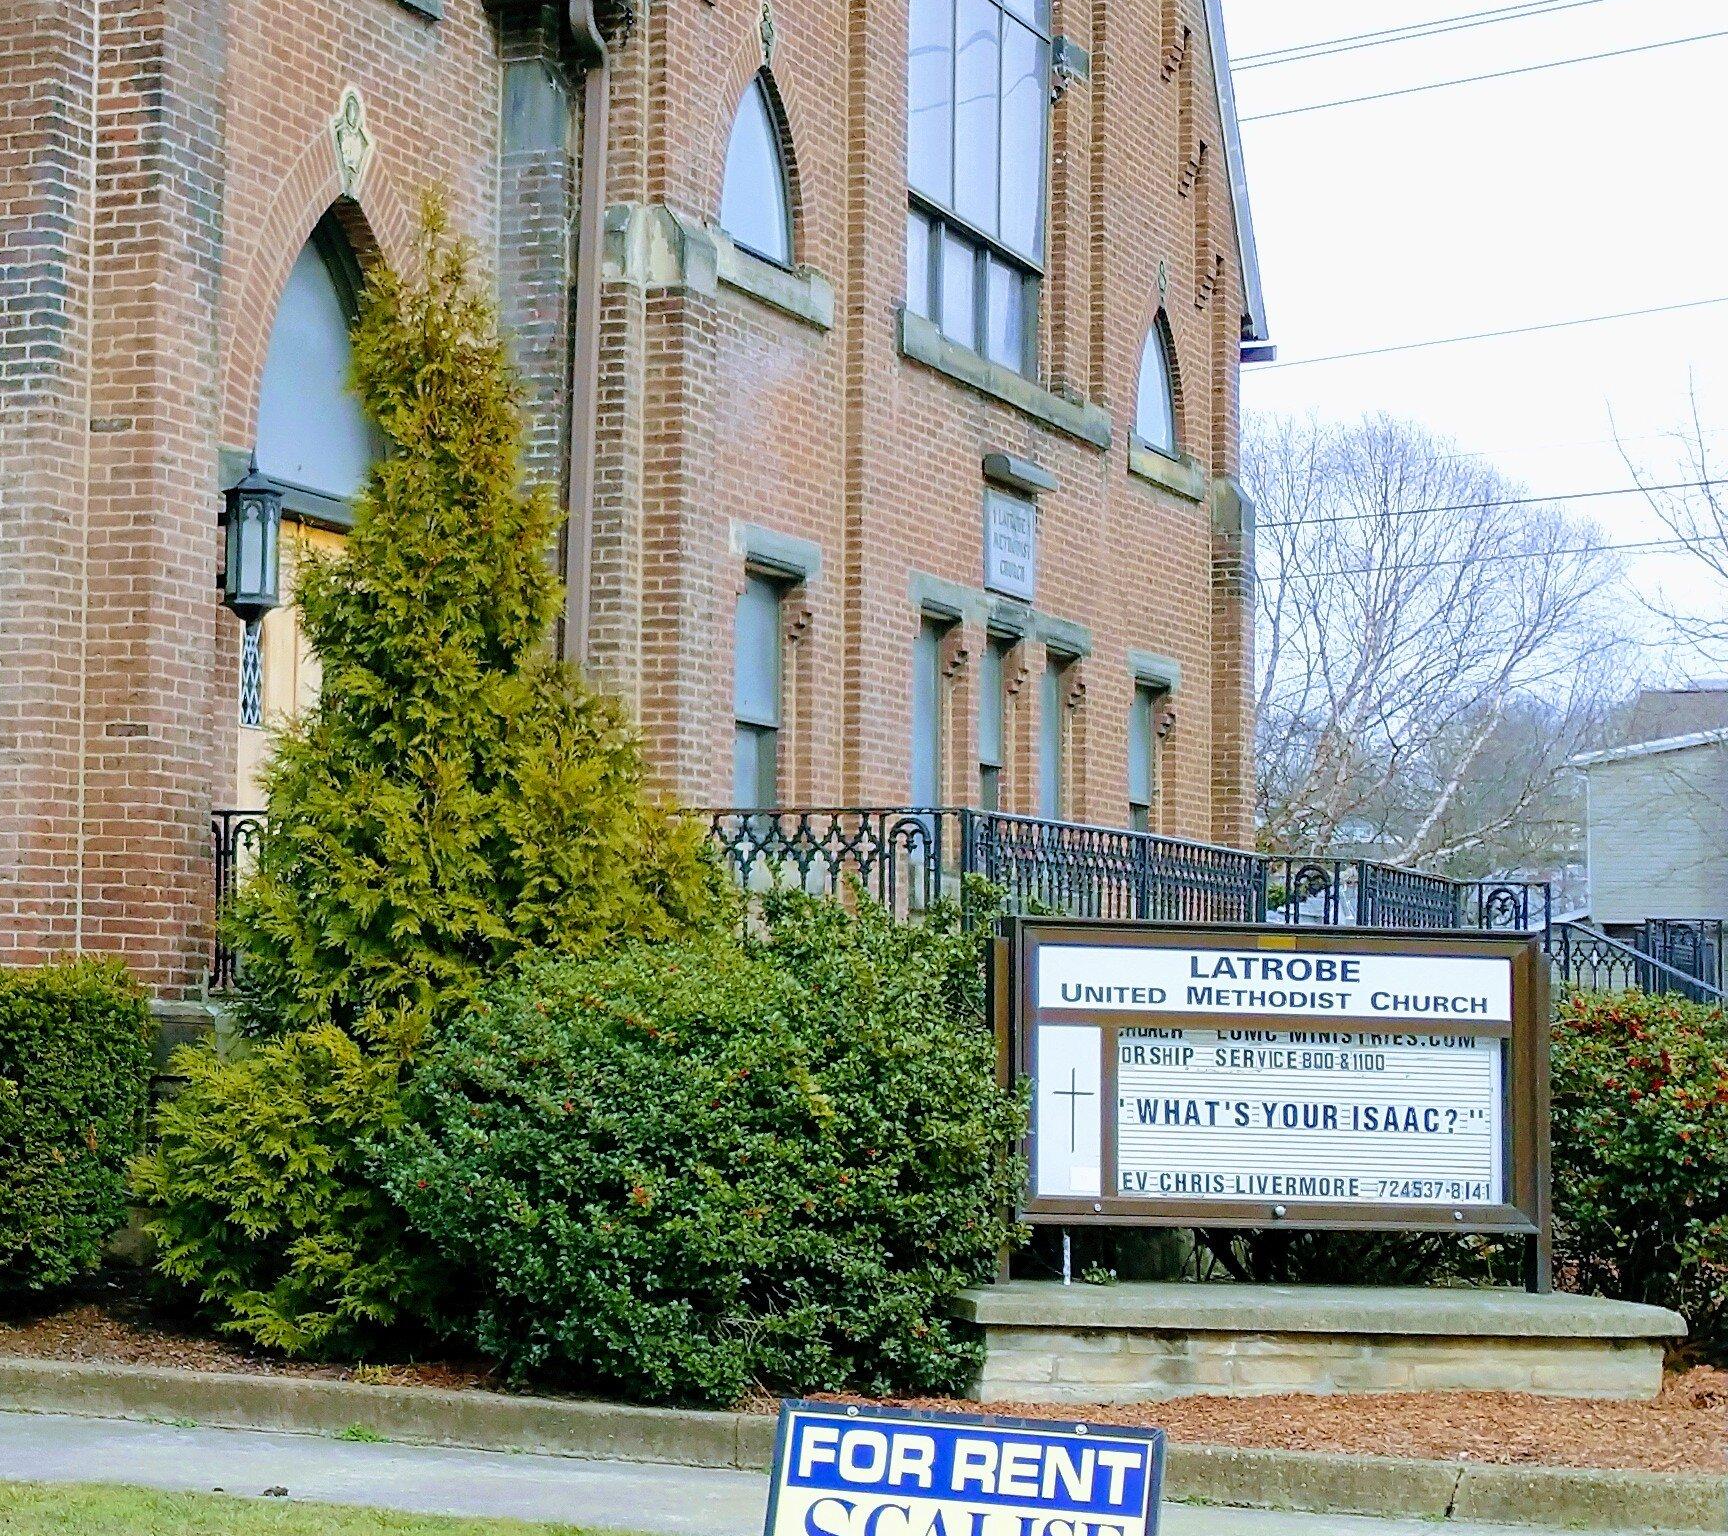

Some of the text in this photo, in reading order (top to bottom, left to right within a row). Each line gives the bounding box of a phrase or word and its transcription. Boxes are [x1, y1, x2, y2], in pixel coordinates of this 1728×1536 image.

[1190, 956, 1361, 983] LATROBE
[1061, 982, 1489, 1014] UNITED METHODIST CHURCH
[1119, 1026, 1183, 1039] HURCH
[1122, 1045, 1194, 1066] ORSHIP
[1215, 1048, 1297, 1069] SERVICE
[1262, 1102, 1338, 1129] YOUR
[1122, 1171, 1148, 1191] EV
[1160, 1172, 1225, 1193] CHRIS
[1235, 1174, 1359, 1196] LIVERMORE
[797, 1425, 1142, 1505] FOR RENT
